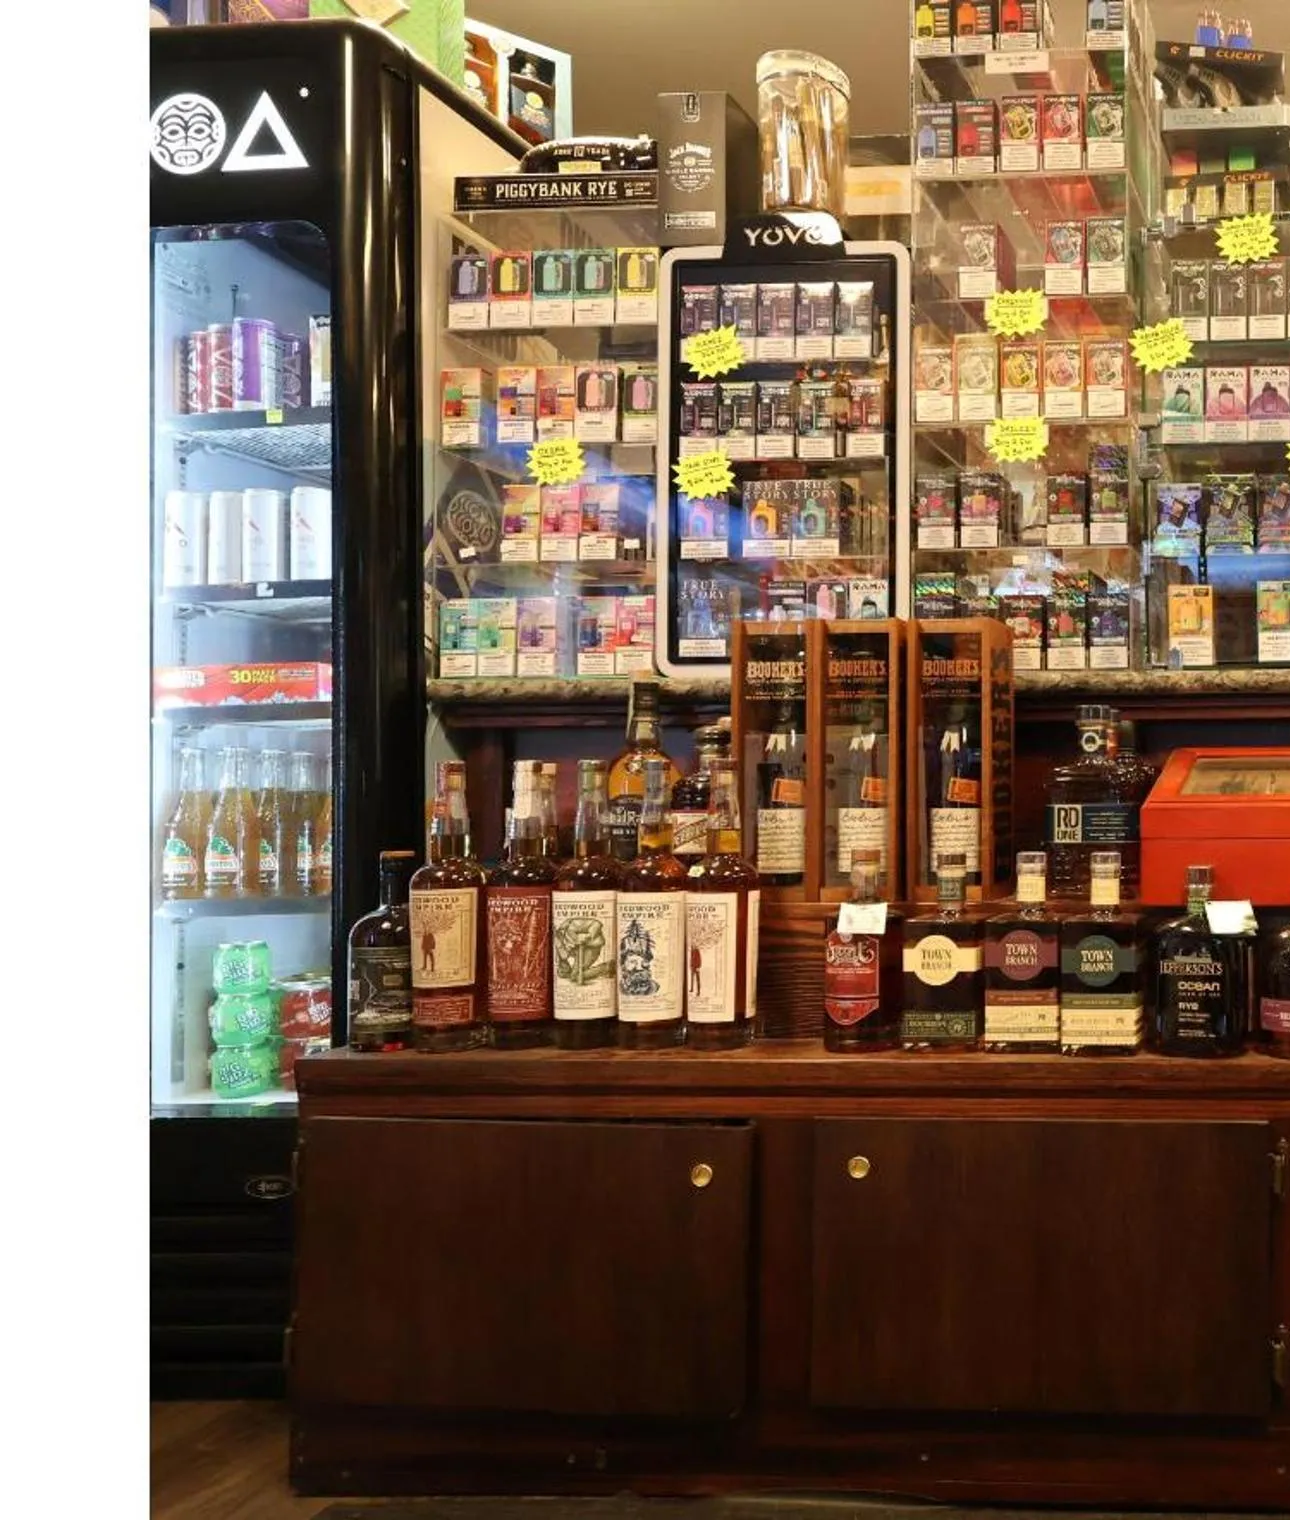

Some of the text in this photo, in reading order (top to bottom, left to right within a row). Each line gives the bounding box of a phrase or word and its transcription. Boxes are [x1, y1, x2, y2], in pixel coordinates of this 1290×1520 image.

[495, 183, 582, 199] PIGGYBANK
[588, 180, 617, 197] RYE
[793, 490, 837, 499] STORY
[829, 660, 887, 677] BOOKER'S
[922, 660, 979, 677] BOOKER'S
[230, 670, 251, 684] 30
[1056, 807, 1079, 829] RD
[920, 949, 952, 961] TOWN
[1005, 943, 1038, 955] TOWN
[1080, 950, 1113, 962] TOWN
[1159, 960, 1223, 976] JEFFERSON'S
[1177, 981, 1221, 991] OCEAN
[1178, 1001, 1199, 1011] RYE
